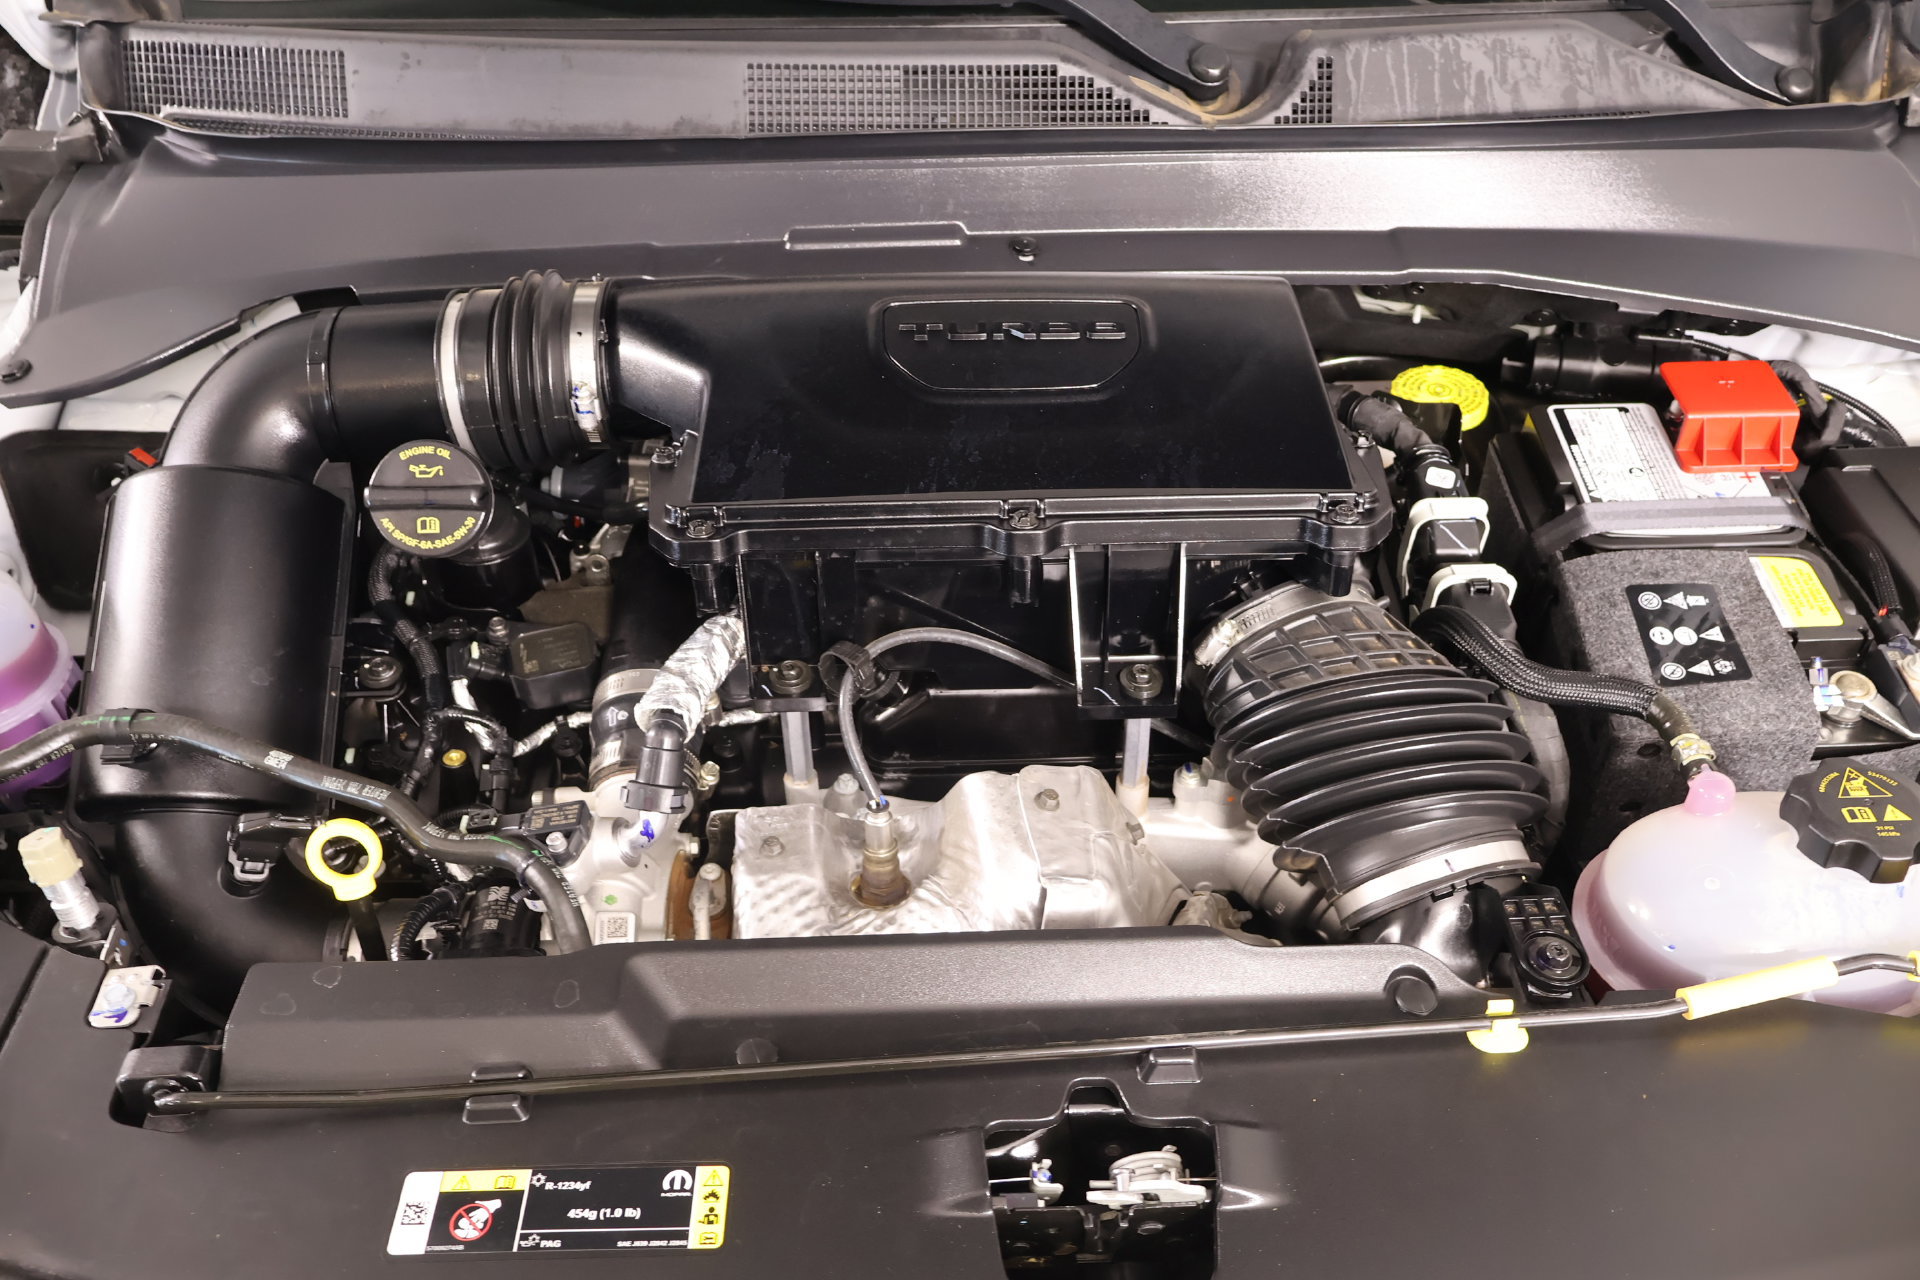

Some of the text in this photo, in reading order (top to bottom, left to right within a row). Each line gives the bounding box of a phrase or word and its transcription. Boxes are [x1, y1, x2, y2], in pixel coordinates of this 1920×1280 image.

[898, 322, 1127, 341] TURBO
[399, 446, 452, 460] ENGINE OIL
[381, 518, 395, 532] API
[544, 1180, 592, 1192] R-1234yf
[567, 1207, 641, 1221] 454g (1.0 lb)
[540, 1239, 562, 1248] PAG
